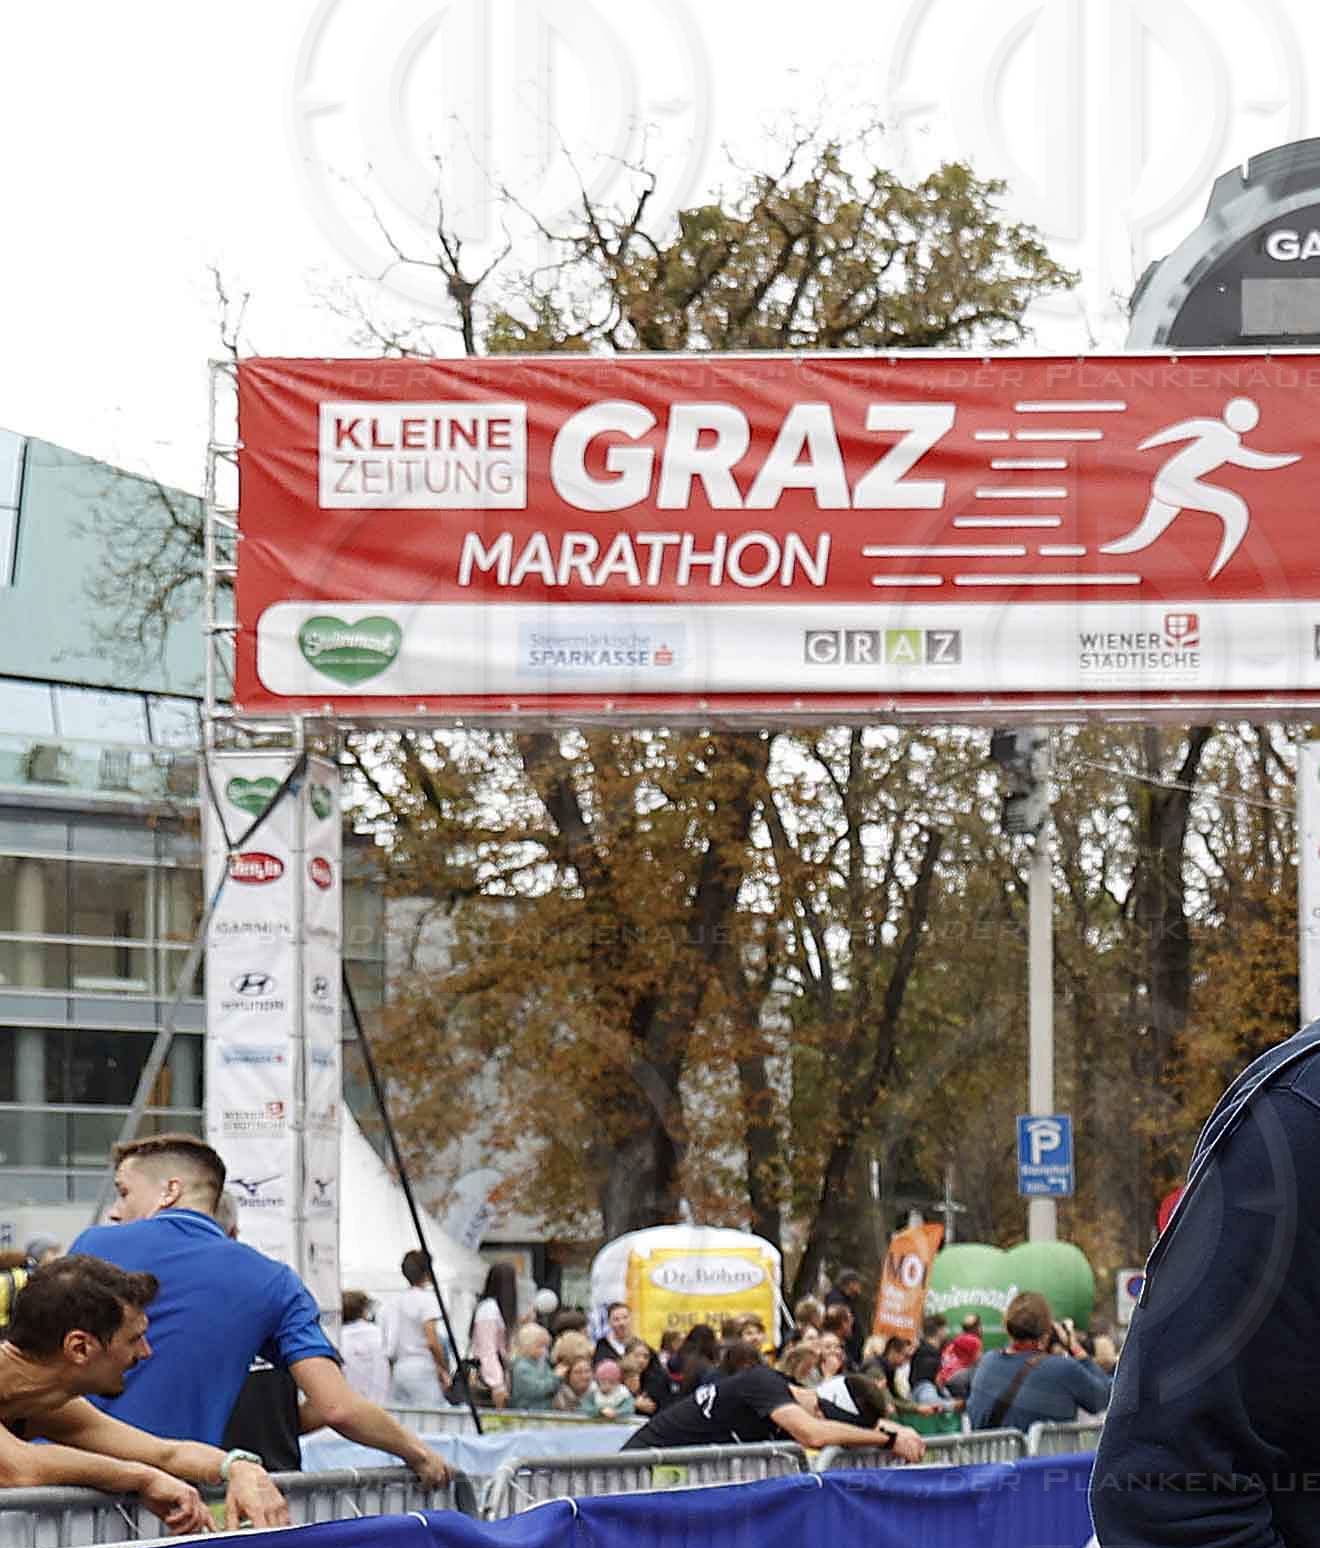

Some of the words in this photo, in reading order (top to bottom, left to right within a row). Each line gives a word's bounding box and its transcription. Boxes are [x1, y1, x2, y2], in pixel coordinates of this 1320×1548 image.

[334, 416, 512, 451] KLEINE
[550, 400, 956, 512] GRAZ
[333, 457, 514, 497] ZEITUNG
[457, 531, 831, 588] MARATHON
[528, 650, 649, 667] SPARKASSE
[806, 631, 959, 664] GRAZ
[1079, 633, 1161, 649] WIENER
[1032, 1129, 1061, 1165] P
